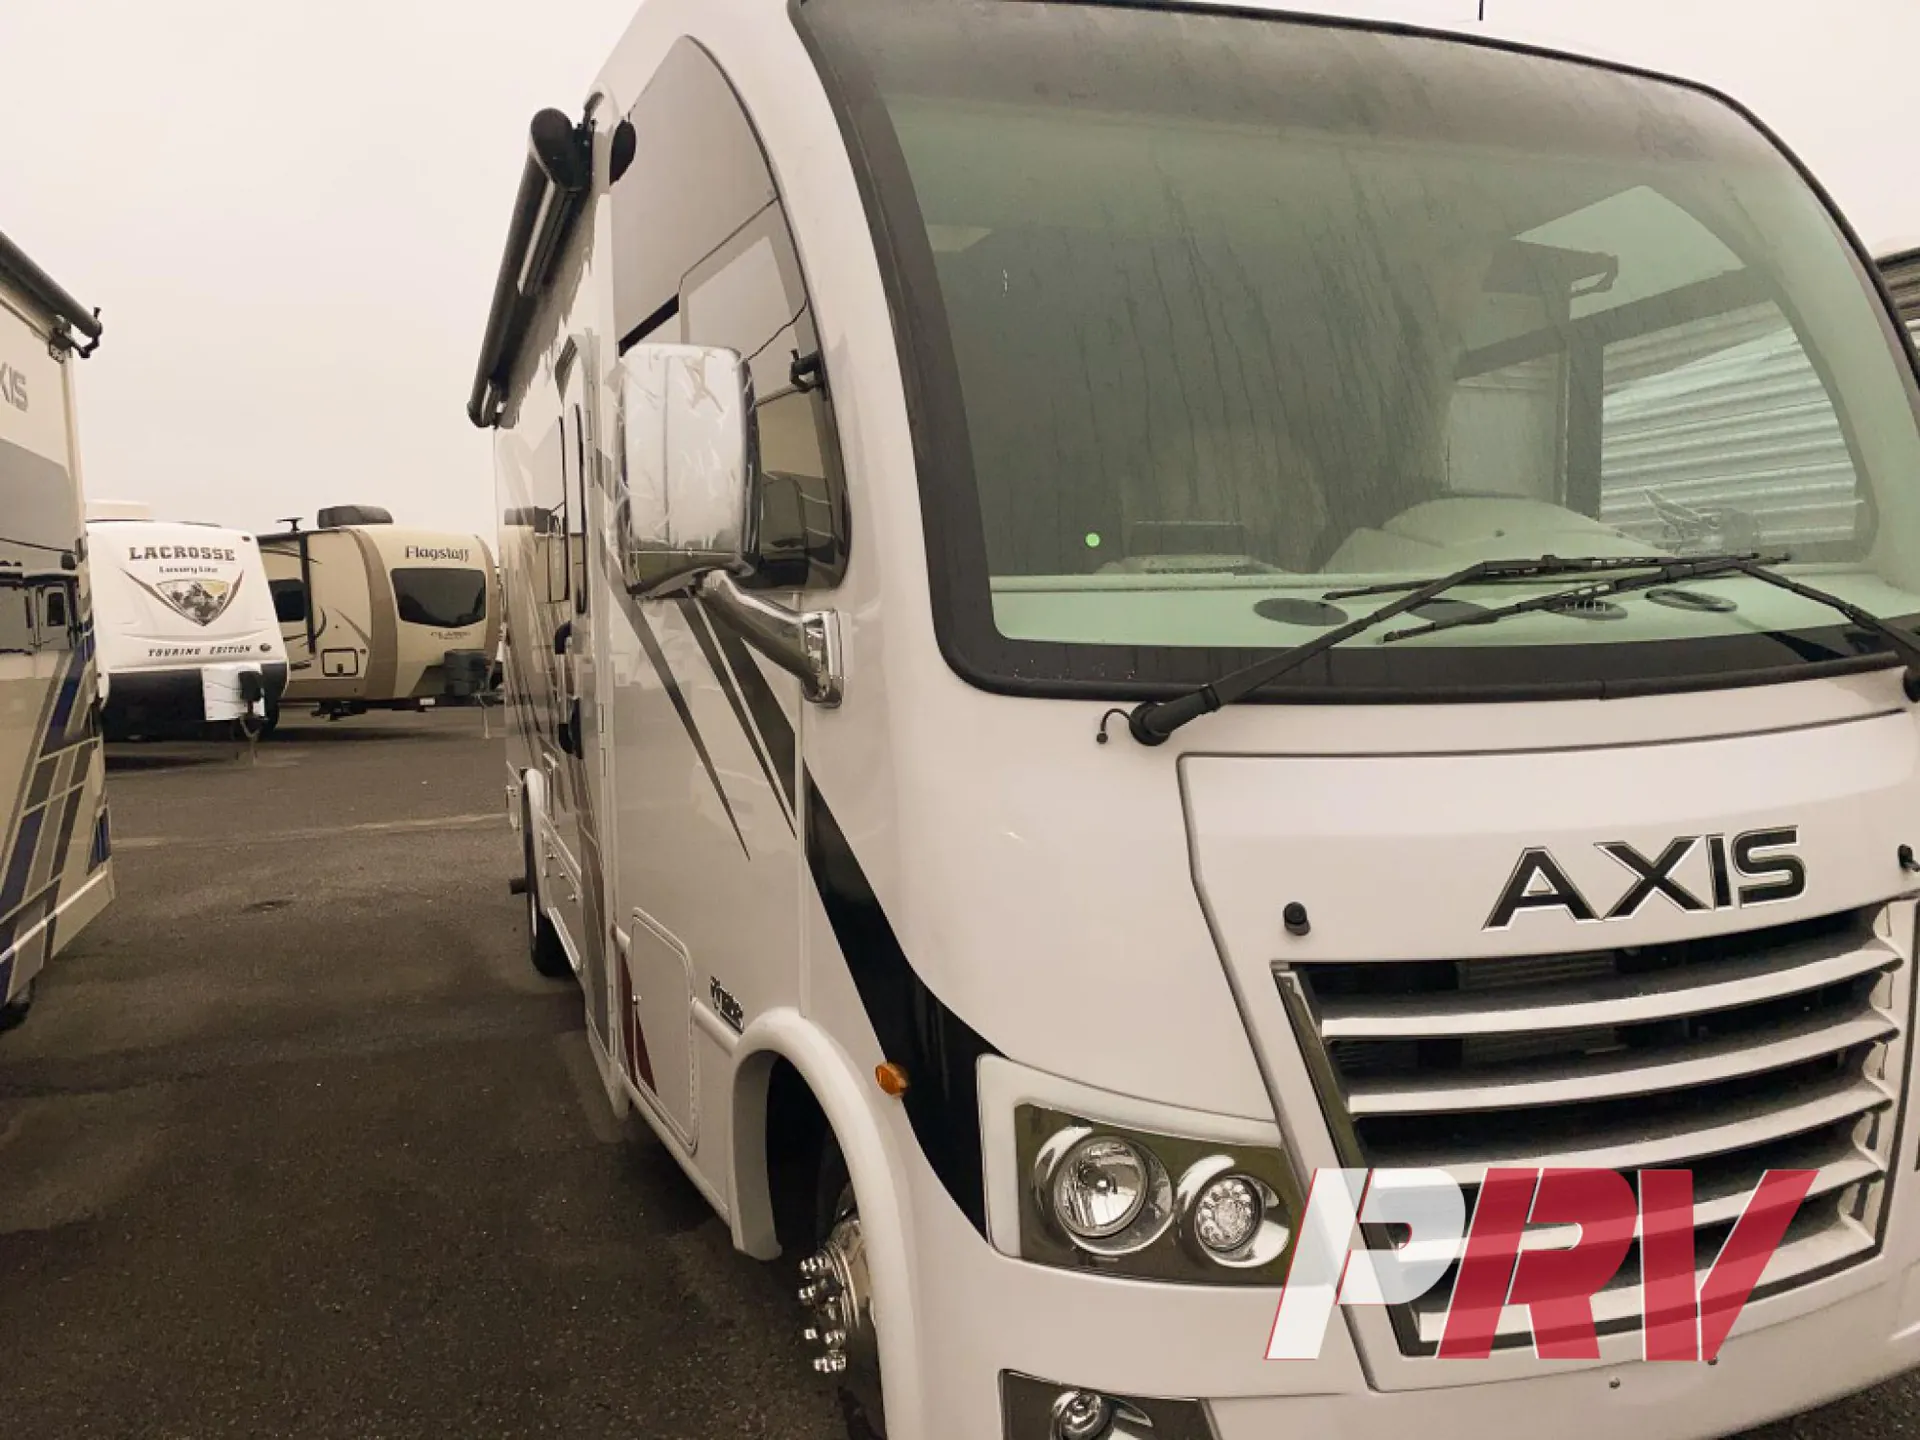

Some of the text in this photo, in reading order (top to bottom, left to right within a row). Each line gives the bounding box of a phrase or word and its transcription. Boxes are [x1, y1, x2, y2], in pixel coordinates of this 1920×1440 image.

[129, 545, 235, 561] LACROSSE
[406, 546, 469, 562] Flagstaff
[148, 645, 252, 657] TOURING EDITION
[1481, 825, 1807, 931] AXIS
